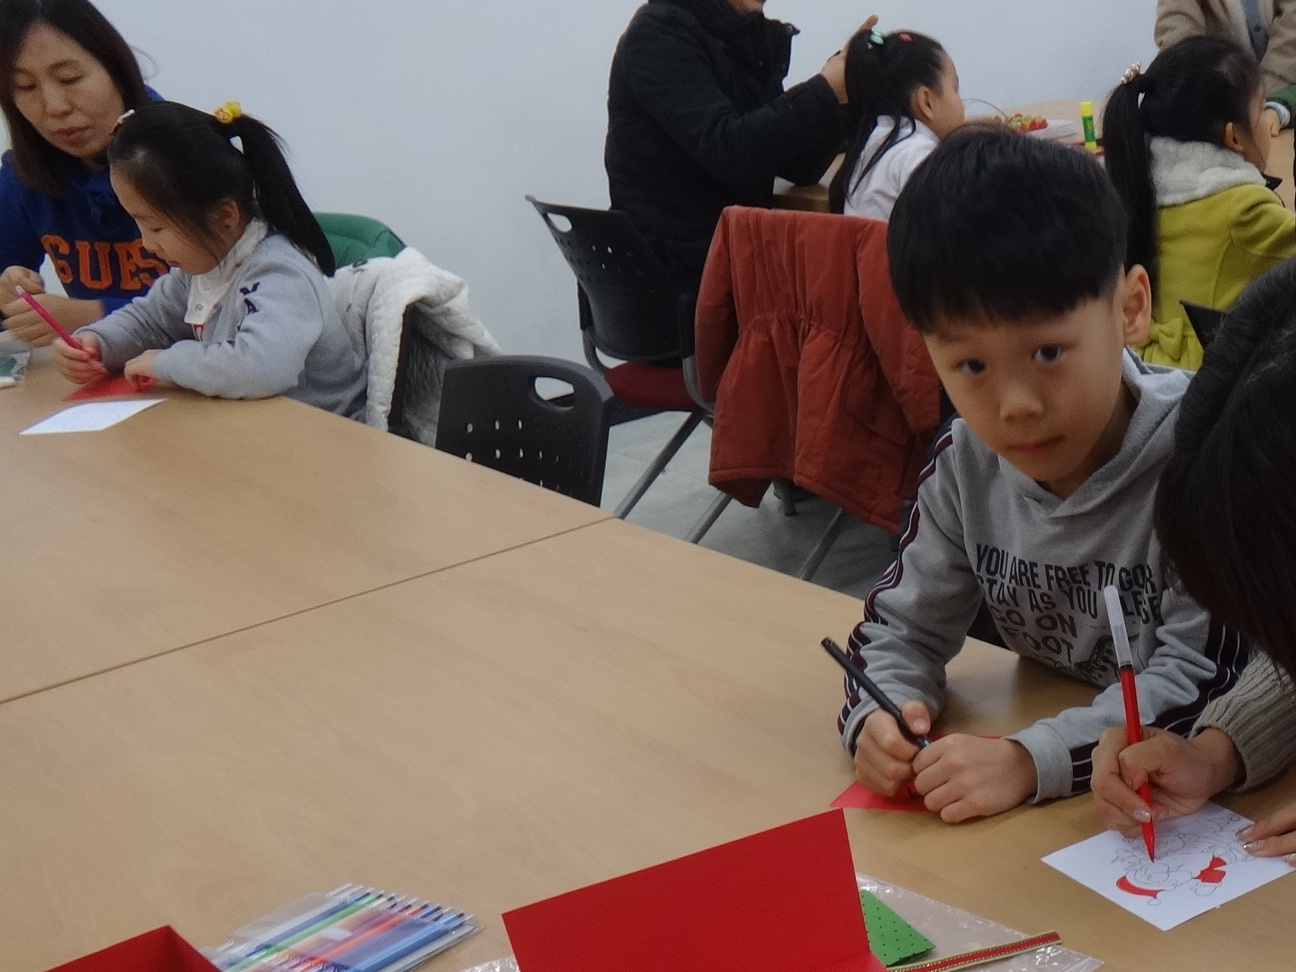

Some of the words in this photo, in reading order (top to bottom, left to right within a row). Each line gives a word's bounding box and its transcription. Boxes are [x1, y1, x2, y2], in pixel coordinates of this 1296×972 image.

[40, 234, 169, 290] GUES
[976, 544, 1009, 579] YOU
[1009, 556, 1041, 589] ARE
[1045, 563, 1091, 591] FREE
[1095, 561, 1115, 591] TO
[1028, 588, 1057, 613] AS
[1062, 585, 1098, 619] YOU
[1001, 624, 1074, 663] FOOT
[1035, 612, 1077, 638] ON
